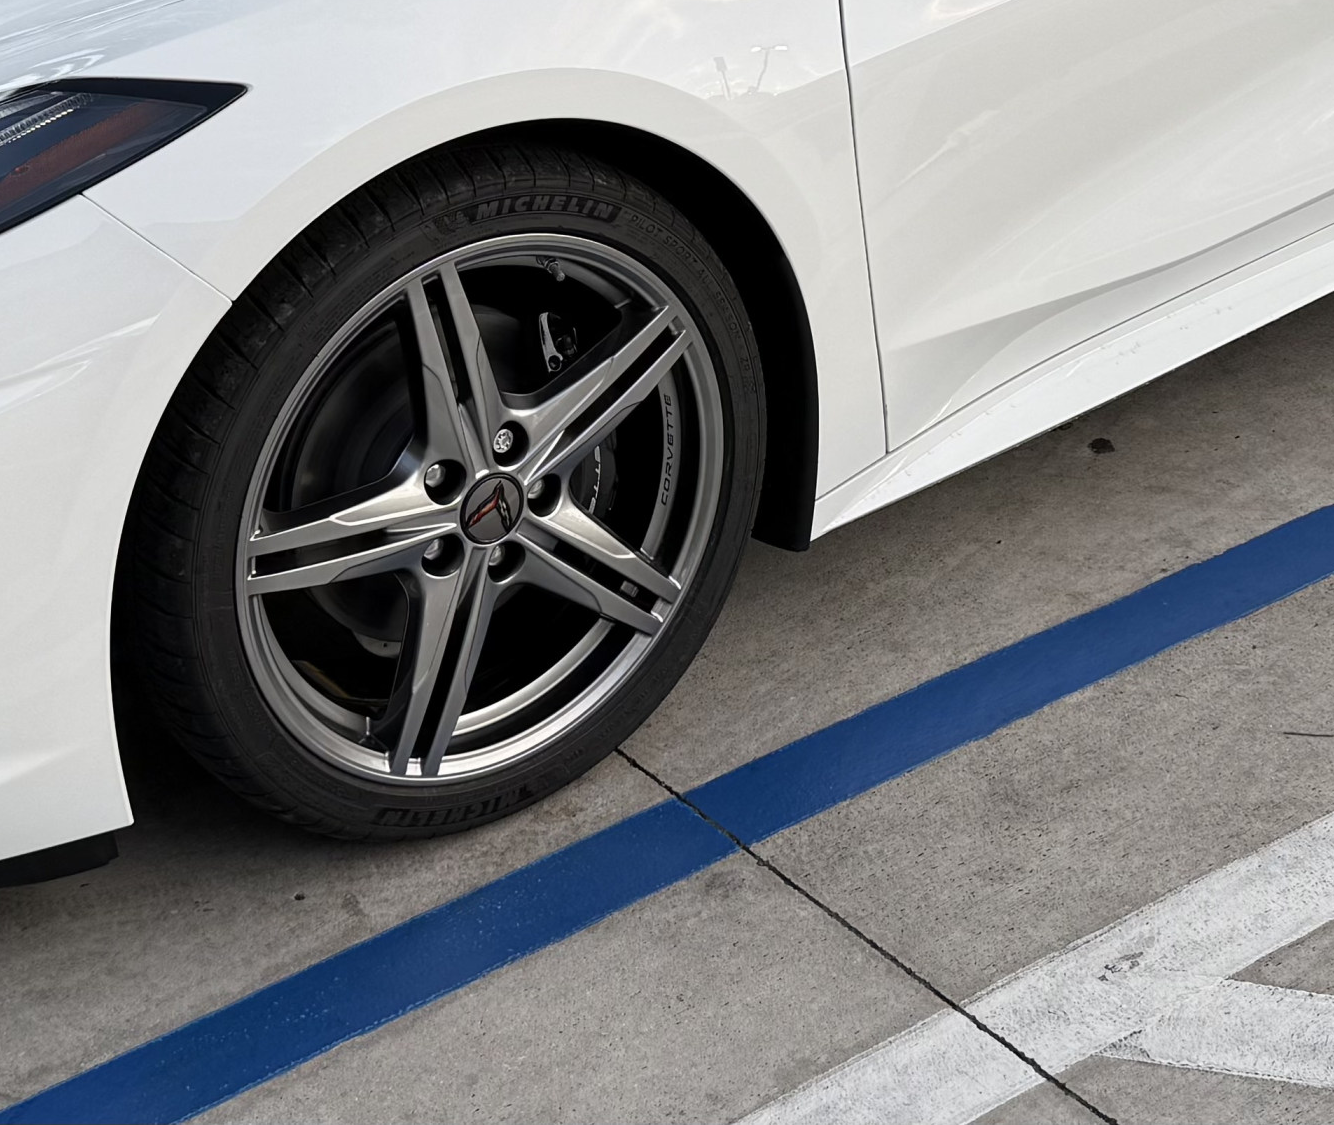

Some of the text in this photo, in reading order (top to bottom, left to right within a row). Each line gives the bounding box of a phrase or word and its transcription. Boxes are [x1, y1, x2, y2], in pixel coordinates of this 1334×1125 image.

[476, 194, 614, 220] MICHELIN
[630, 214, 664, 238] PILOT
[662, 235, 698, 263] SPORT
[660, 393, 674, 506] CORVETTE
[378, 789, 519, 826] MICHELIN
